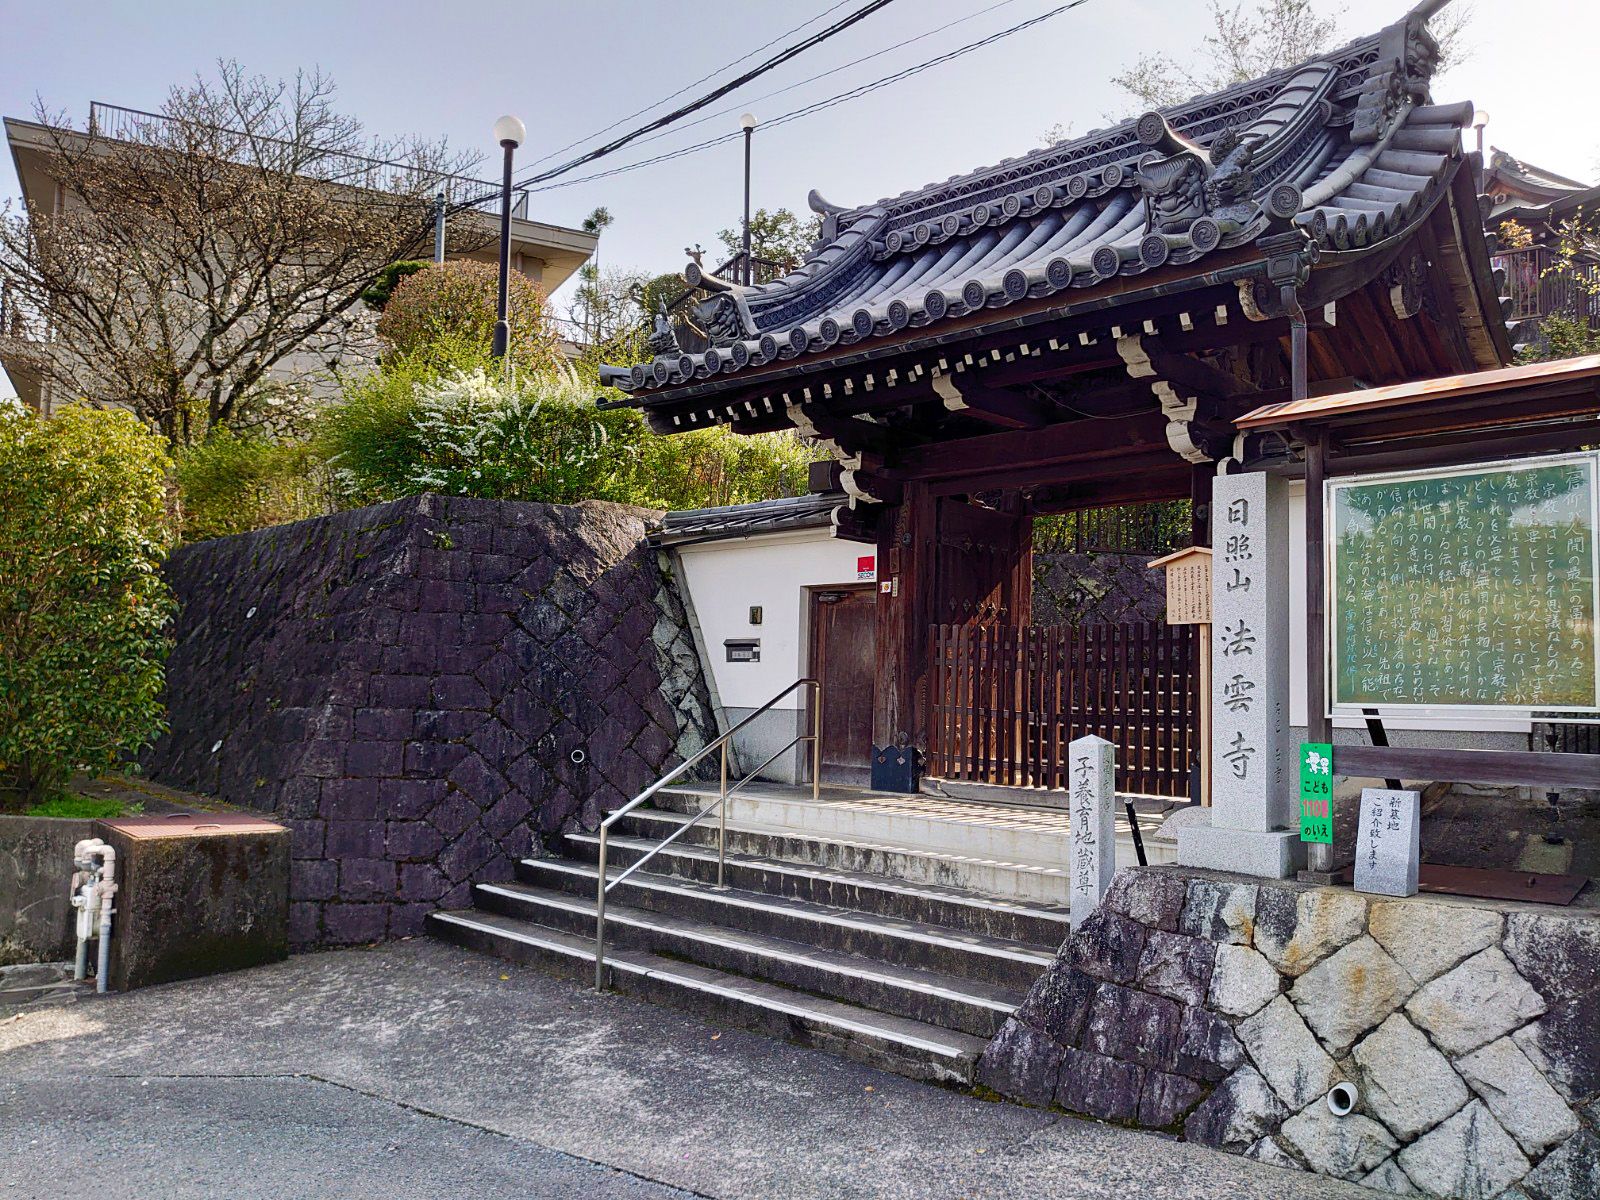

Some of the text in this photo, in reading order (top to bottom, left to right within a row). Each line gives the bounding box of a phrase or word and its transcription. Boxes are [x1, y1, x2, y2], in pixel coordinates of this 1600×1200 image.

[1220, 497, 1256, 780] 日照山 法雲寺
[1304, 780, 1329, 794] こども
[1386, 797, 1402, 831] 新墓地
[1304, 824, 1329, 838] のいえ
